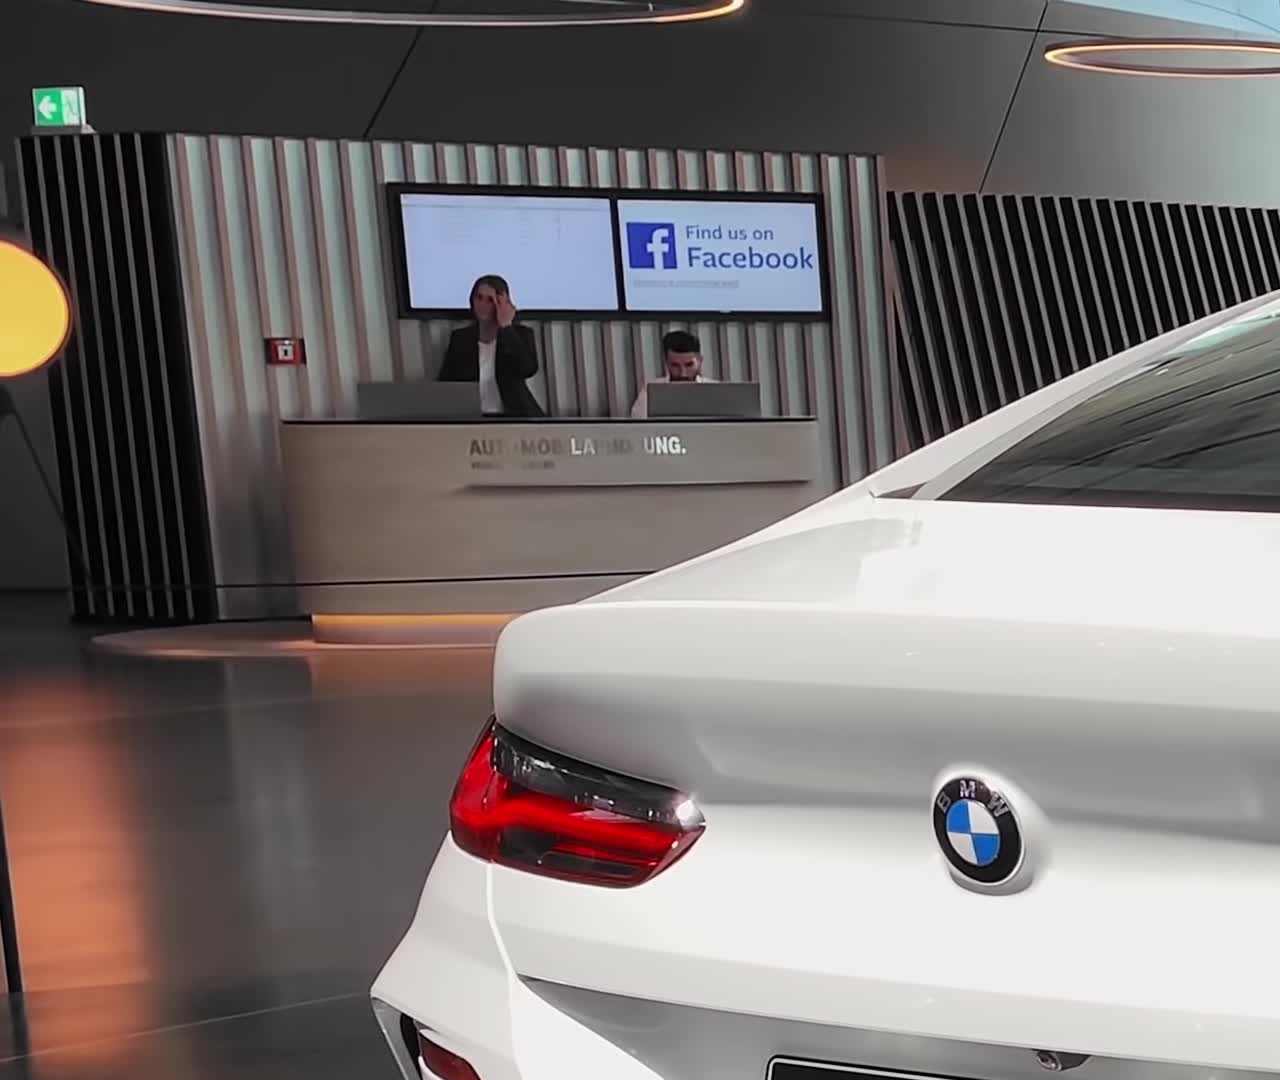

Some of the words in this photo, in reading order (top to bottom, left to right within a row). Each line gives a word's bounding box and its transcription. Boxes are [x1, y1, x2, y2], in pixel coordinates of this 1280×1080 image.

[686, 225, 722, 240] Find
[728, 229, 747, 241] us
[753, 229, 774, 241] on
[687, 246, 813, 270] Facebook
[937, 780, 1010, 817] BMW
